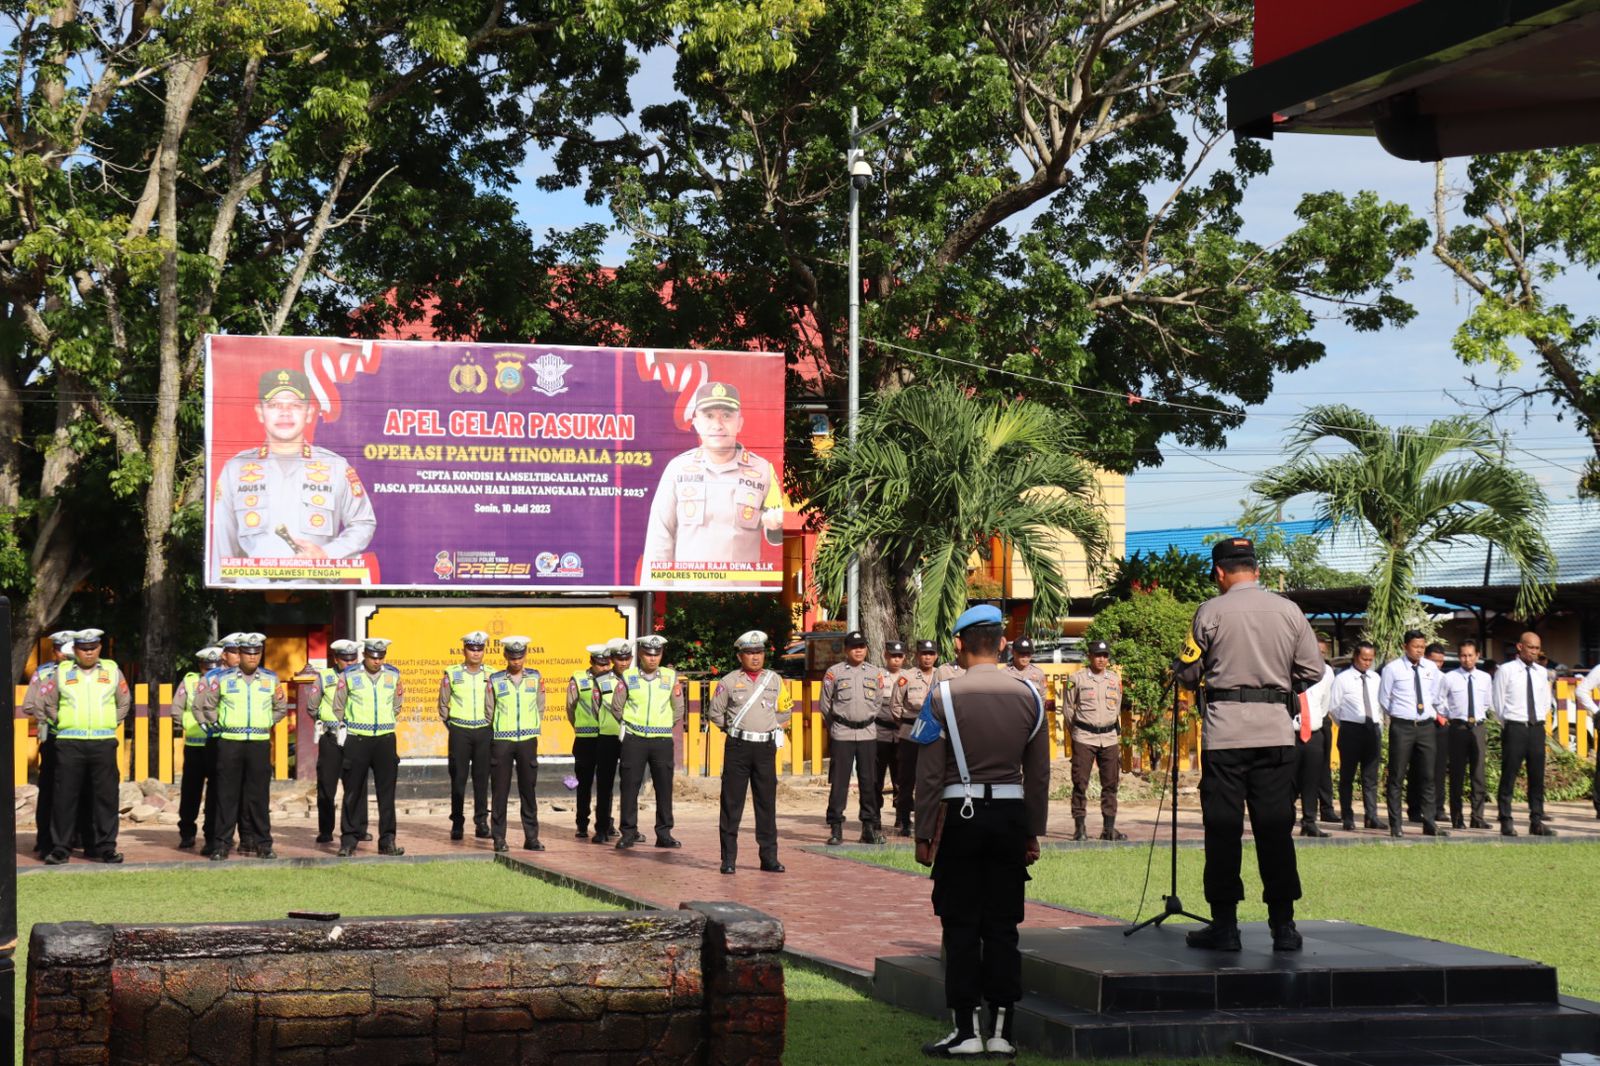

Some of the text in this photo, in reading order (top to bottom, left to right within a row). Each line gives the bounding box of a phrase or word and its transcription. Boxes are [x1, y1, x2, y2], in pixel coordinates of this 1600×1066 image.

[384, 409, 635, 440] APEL GELAR PASUKAN
[364, 444, 653, 467] OPERASI PATUH TINOMBALA 2023
[452, 471, 494, 481] KONDISI
[495, 471, 608, 483] KAMSELTIBCARLANTAS
[237, 484, 259, 493] AGUS
[303, 483, 332, 493] POLRI
[374, 483, 407, 493] PASCA
[408, 484, 483, 494] PELAKSANAAN
[484, 485, 510, 494] HARI
[511, 485, 587, 496] BHAYANGKARA
[588, 486, 621, 496] TAHUN
[739, 478, 765, 491] POLRI
[474, 503, 551, 514] Senin, 10 Juli 2023
[222, 568, 260, 576] KAPOLDA
[308, 569, 341, 577] TENGAH
[457, 563, 531, 574] PRESISI
[651, 571, 727, 579] KAPOLRES TOLITOLI
